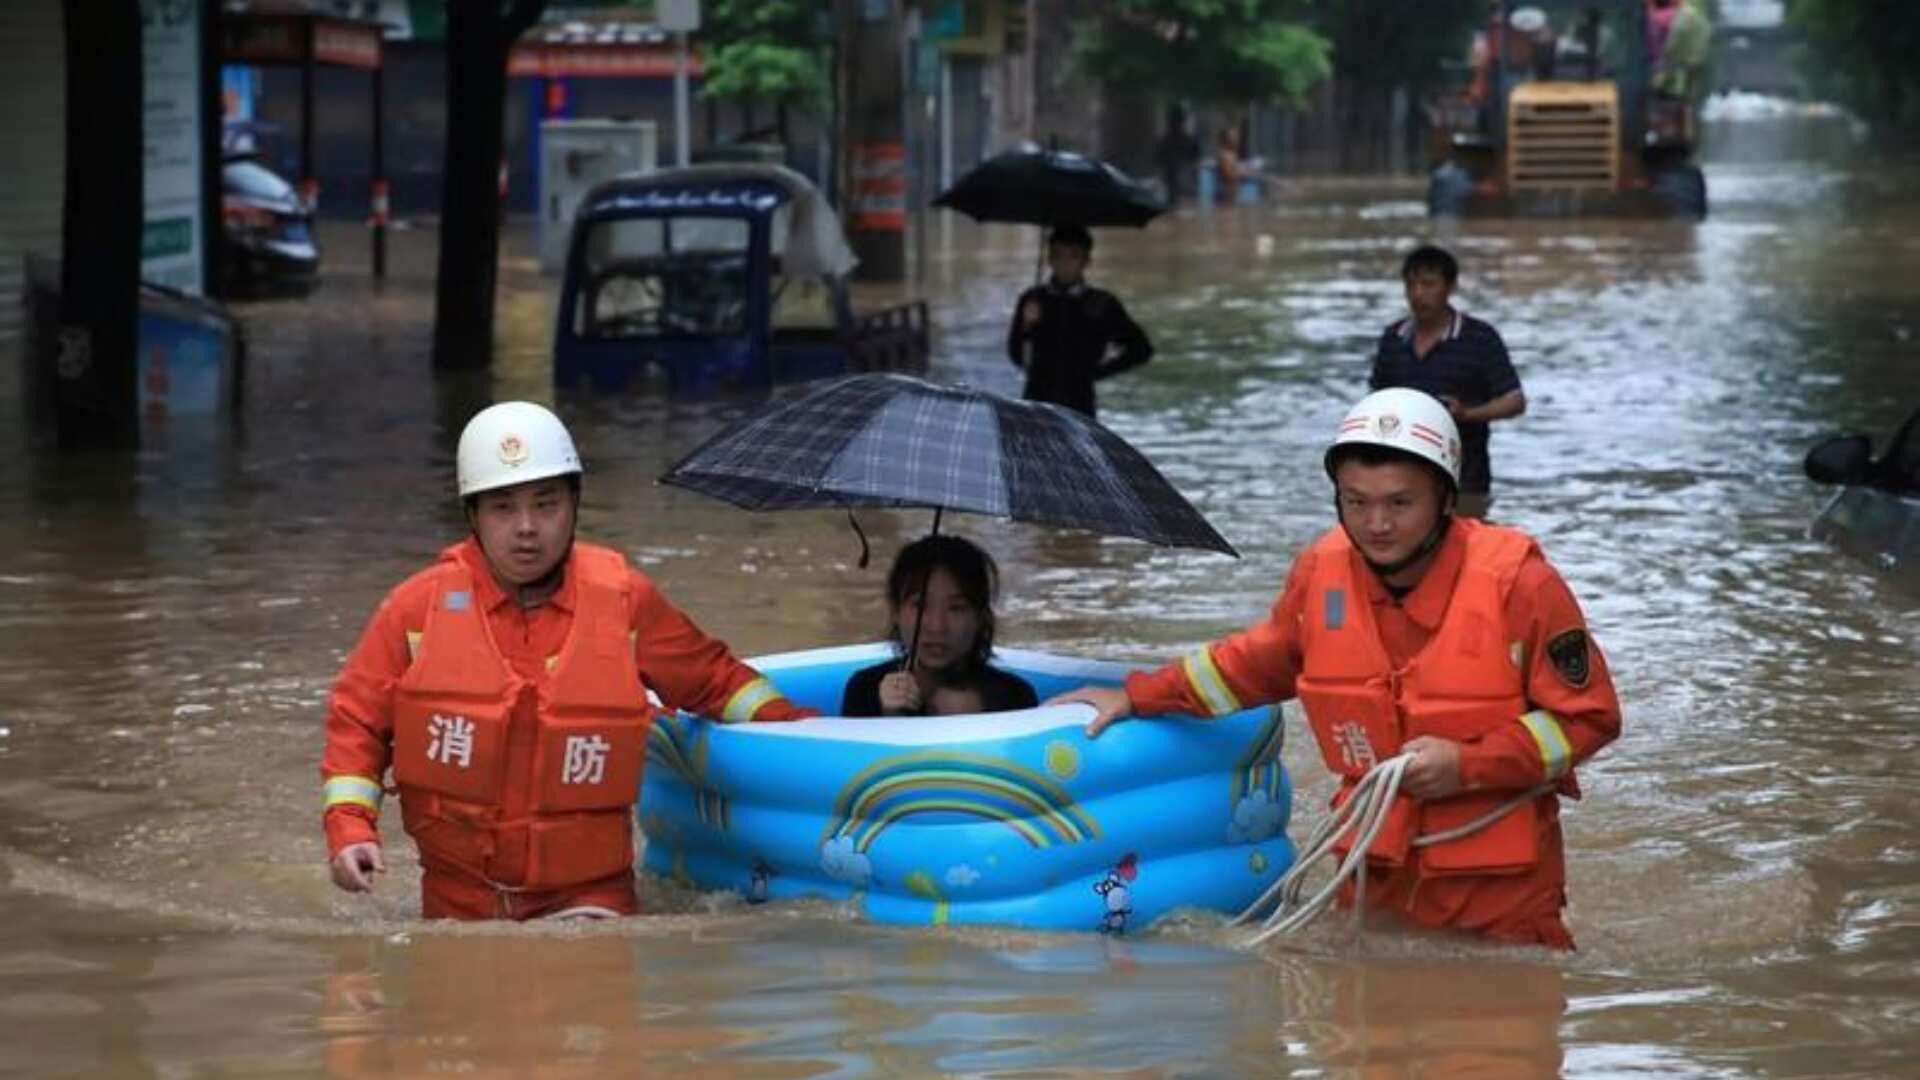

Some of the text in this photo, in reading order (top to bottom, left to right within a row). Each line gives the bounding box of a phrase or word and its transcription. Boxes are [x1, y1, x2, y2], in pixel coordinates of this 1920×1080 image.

[426, 714, 612, 785] 消 防
[1331, 722, 1377, 770] 消
